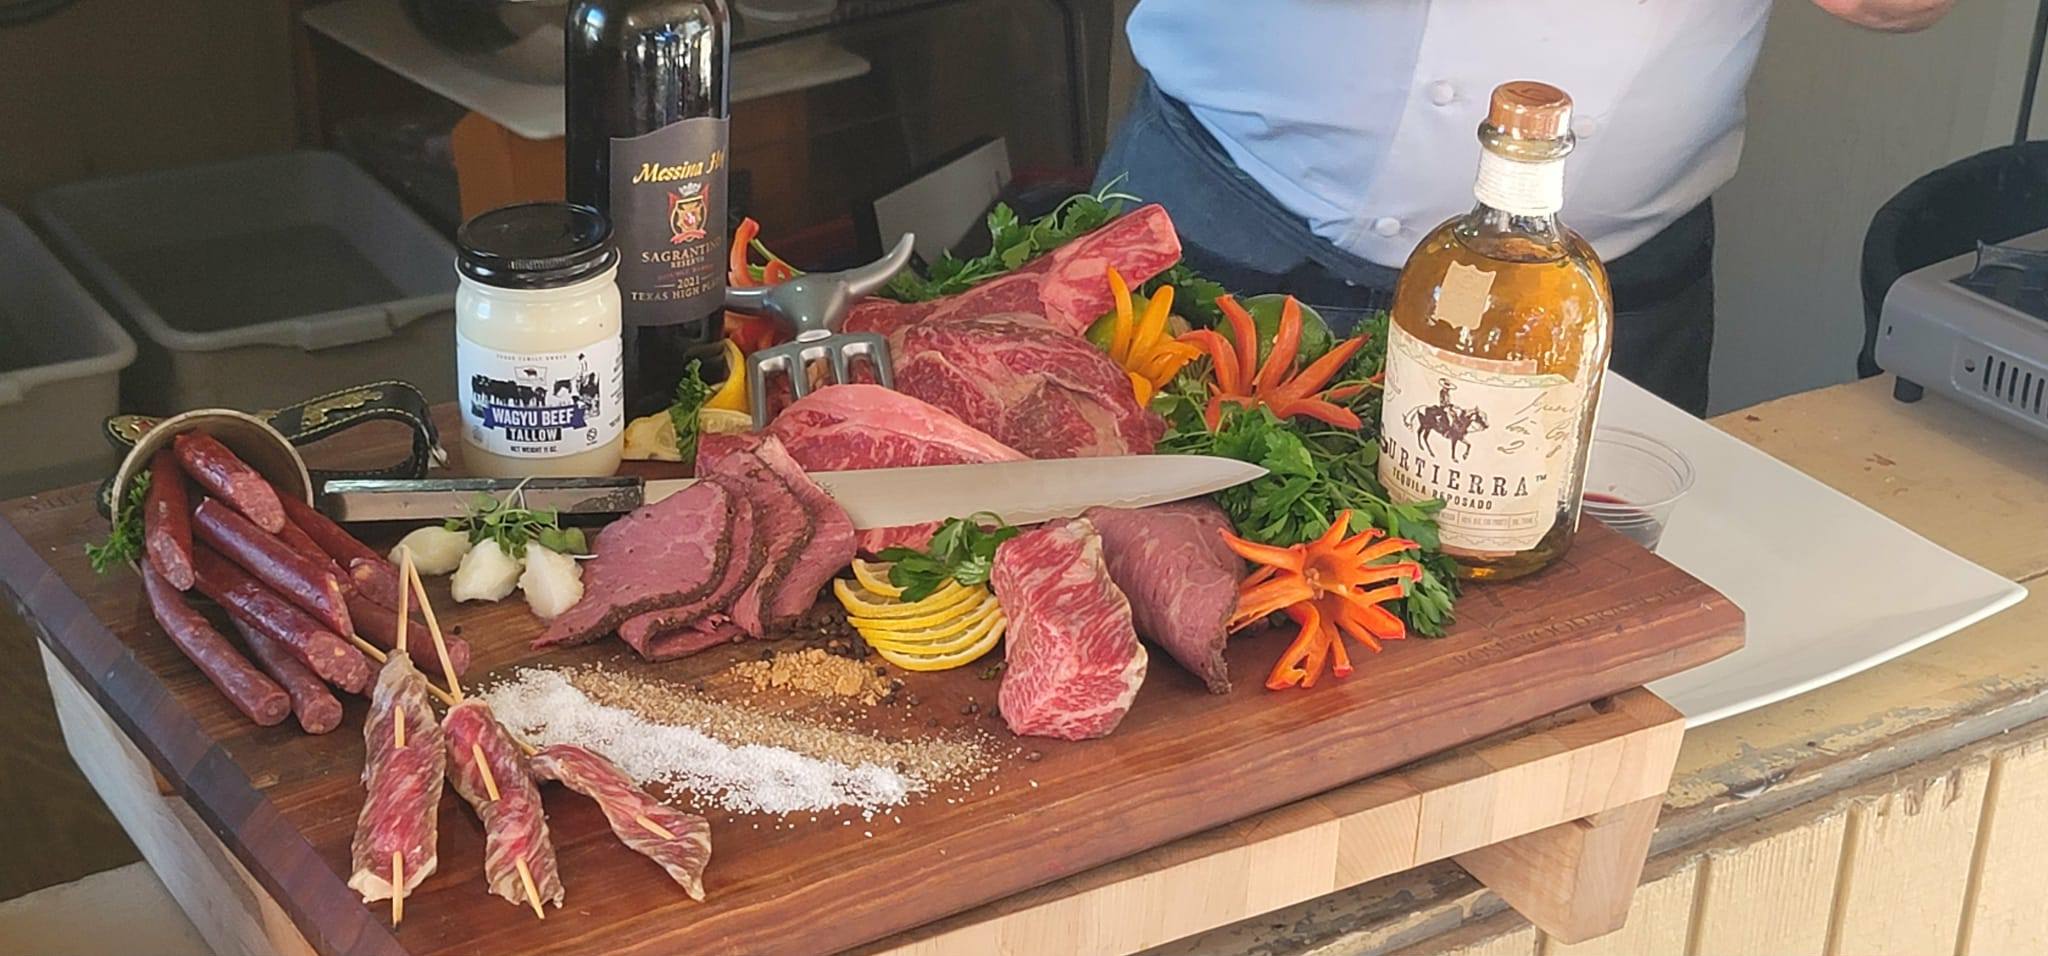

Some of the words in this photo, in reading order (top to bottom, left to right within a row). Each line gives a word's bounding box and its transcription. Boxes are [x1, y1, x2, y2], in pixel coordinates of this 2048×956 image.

[632, 161, 704, 184] Messina
[677, 275, 700, 290] 2021
[631, 291, 669, 302] TEXAS
[672, 285, 700, 301] HIGH
[492, 407, 538, 427] WAGYU
[541, 408, 575, 427] BEEF
[509, 428, 558, 441] TALLOW
[522, 446, 541, 454] WEIGHT
[1392, 467, 1427, 495] TEQUILA
